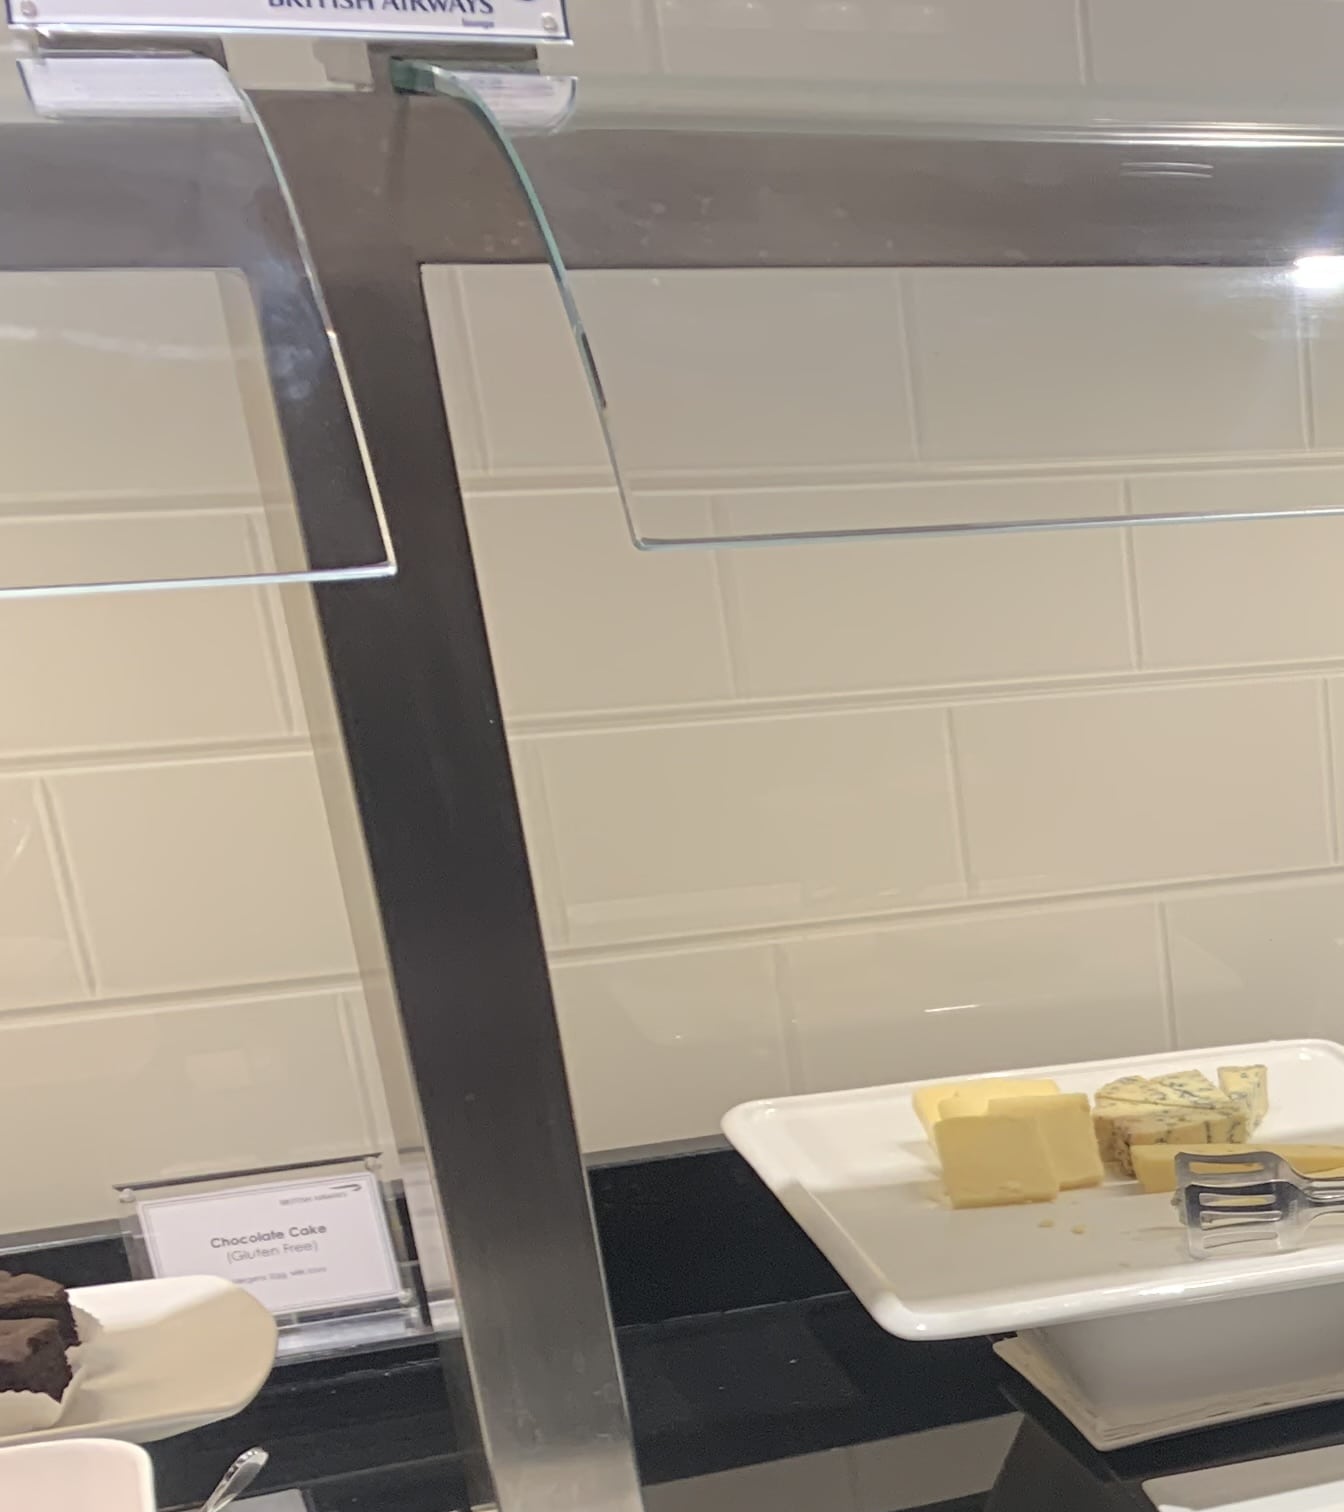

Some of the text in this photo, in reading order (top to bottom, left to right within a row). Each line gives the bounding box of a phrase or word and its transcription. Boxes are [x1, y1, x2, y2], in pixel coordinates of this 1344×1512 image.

[381, 0, 494, 14] AIRWAYS
[210, 1224, 327, 1248] Chocolate Cake
[226, 1240, 319, 1264] (Gluten Free)
